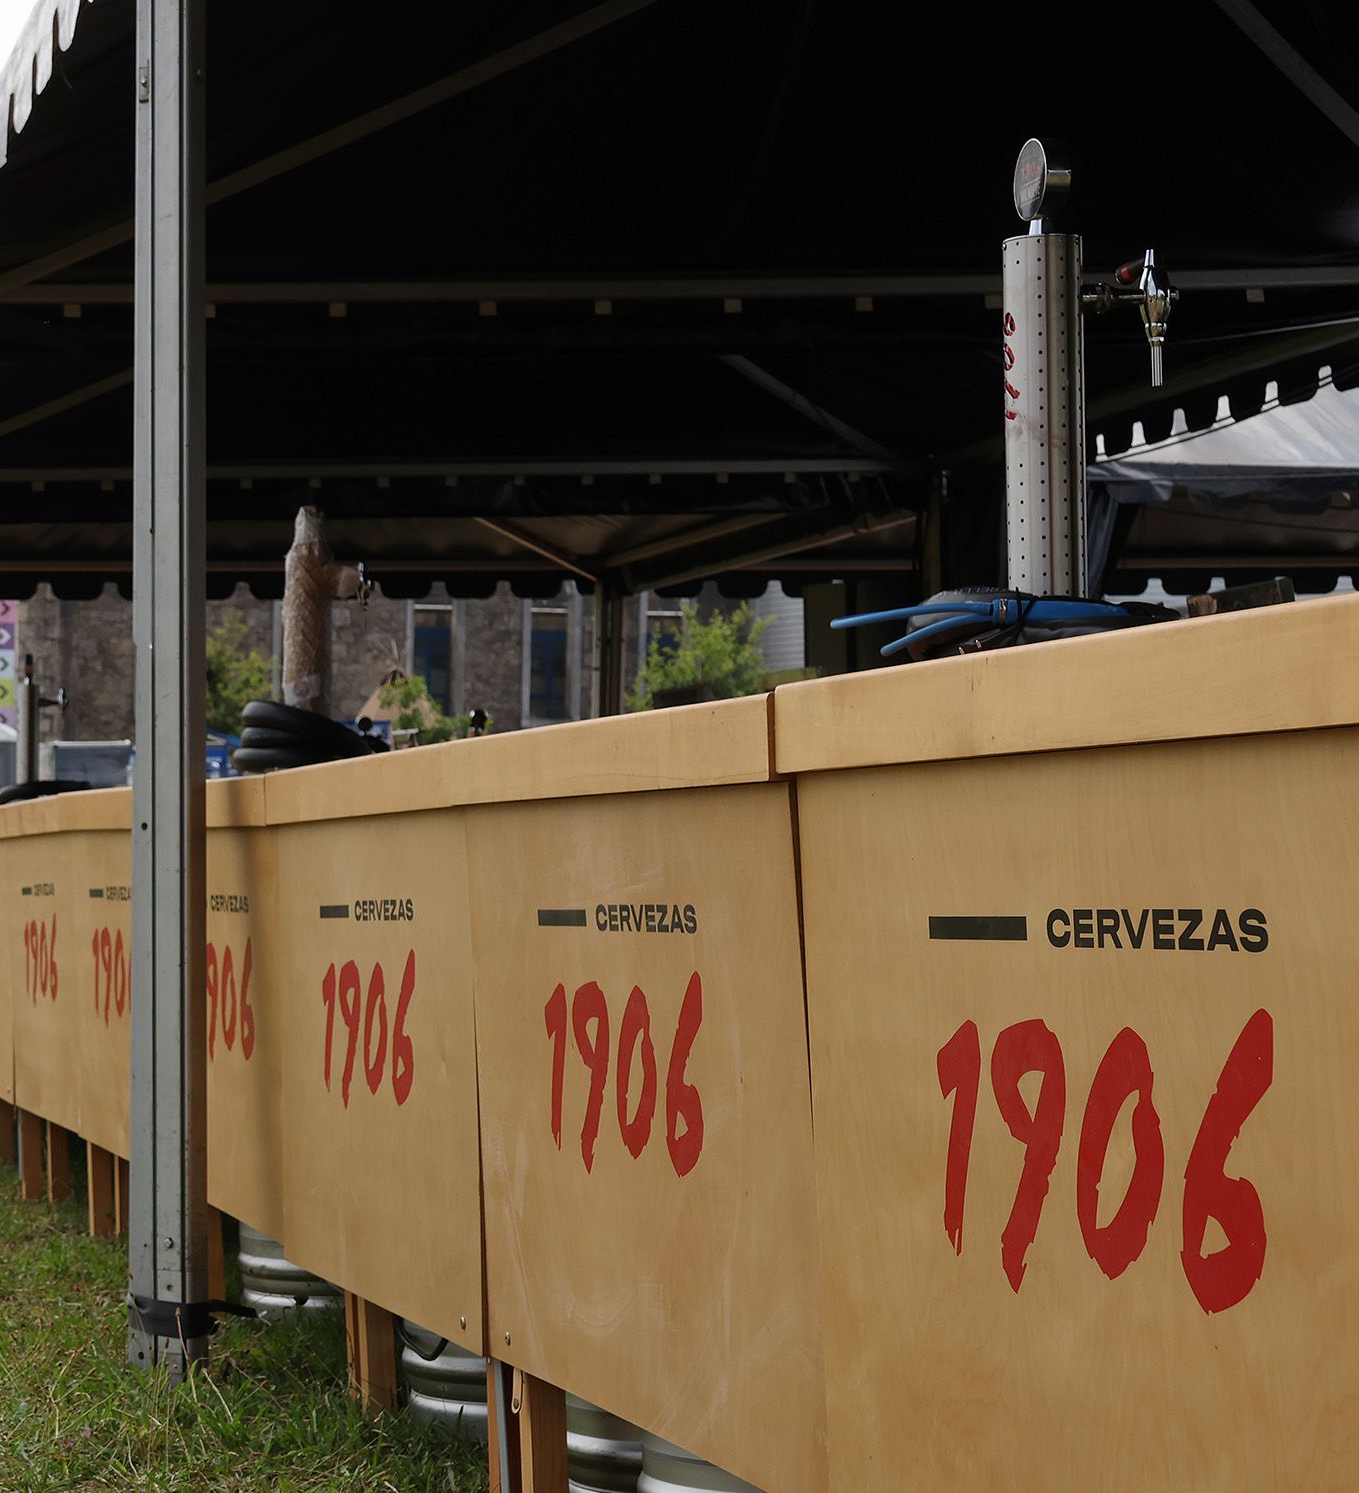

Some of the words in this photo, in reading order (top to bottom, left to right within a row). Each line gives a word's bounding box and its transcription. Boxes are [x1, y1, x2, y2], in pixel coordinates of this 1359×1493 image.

[106, 886, 131, 901] CERVEZA
[210, 895, 249, 913] CERVEZAS
[354, 899, 414, 922] CERVEZAS
[595, 904, 698, 934] CERVEZAS
[1046, 908, 1269, 953] CERVEZAS
[24, 912, 58, 1007] 1906
[93, 926, 131, 1028] 190
[206, 936, 255, 1063] 906
[322, 949, 416, 1110] 1906
[545, 971, 704, 1178] 1906
[937, 1008, 1274, 1316] 1906
